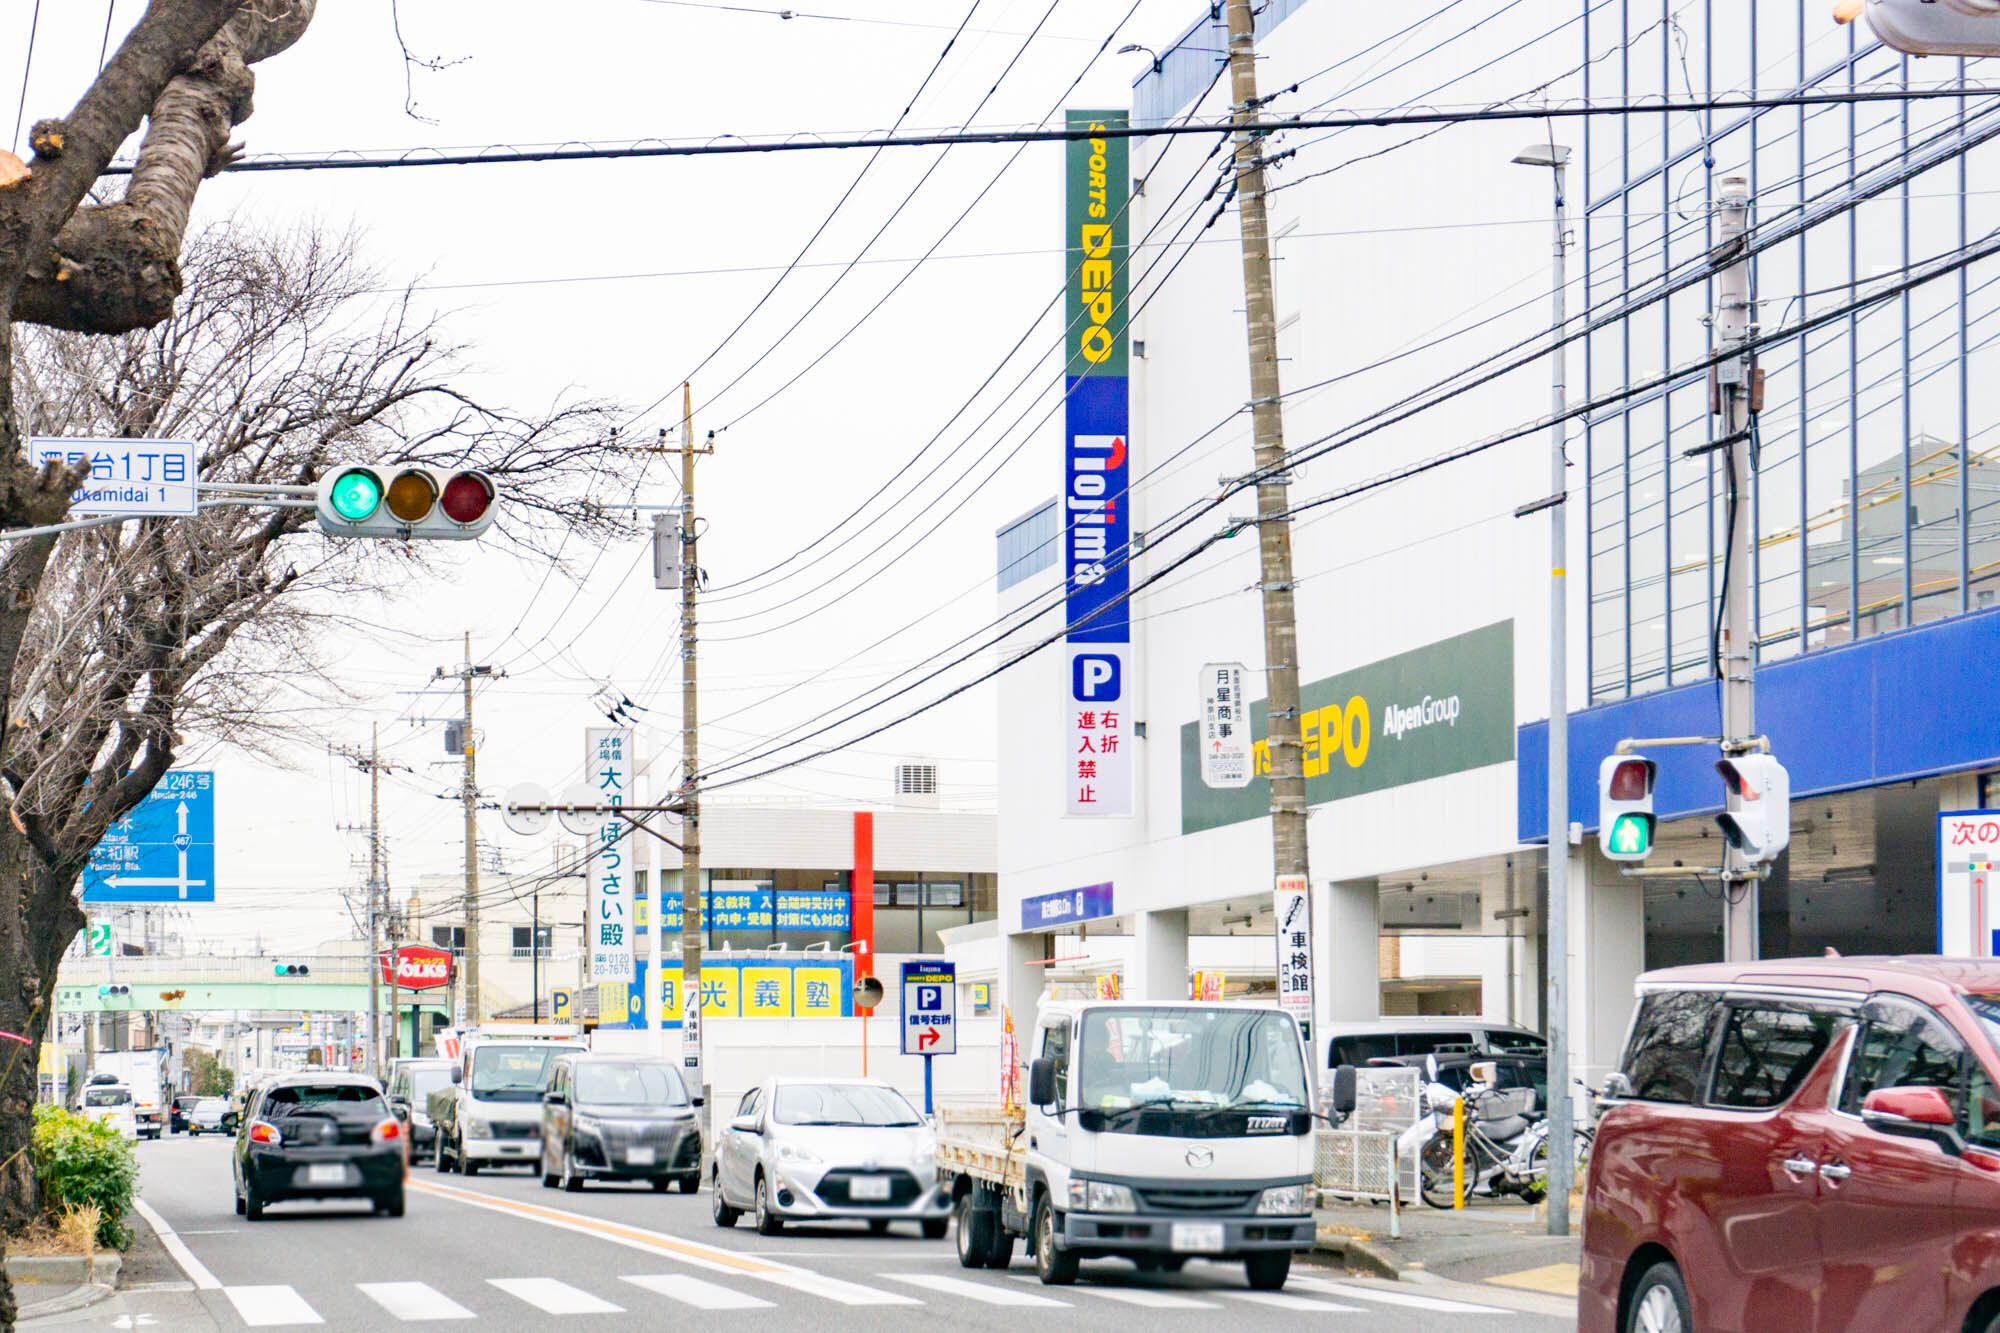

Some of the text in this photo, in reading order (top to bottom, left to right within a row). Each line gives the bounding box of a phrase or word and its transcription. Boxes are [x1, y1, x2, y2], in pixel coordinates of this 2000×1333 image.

[1081, 122, 1113, 364] SPORTS DEPO
[71, 486, 166, 503] ukamidai 1
[1083, 659, 1112, 697] P
[1217, 669, 1233, 738] 月星商事
[1100, 710, 1119, 753] 右折
[1300, 695, 1371, 778] EPO
[600, 737, 610, 760] 式場
[1077, 711, 1097, 803] 進入禁止
[175, 836, 191, 846] 467
[1952, 821, 2000, 846] 次の
[713, 896, 751, 909] 全教科
[608, 952, 630, 963] 0120
[1290, 931, 1309, 992] 車検館
[594, 964, 630, 975] 20-7676
[925, 974, 953, 983] DEPO
[553, 992, 569, 1014] P
[922, 988, 937, 1008] P
[909, 1014, 951, 1025] 信号右折
